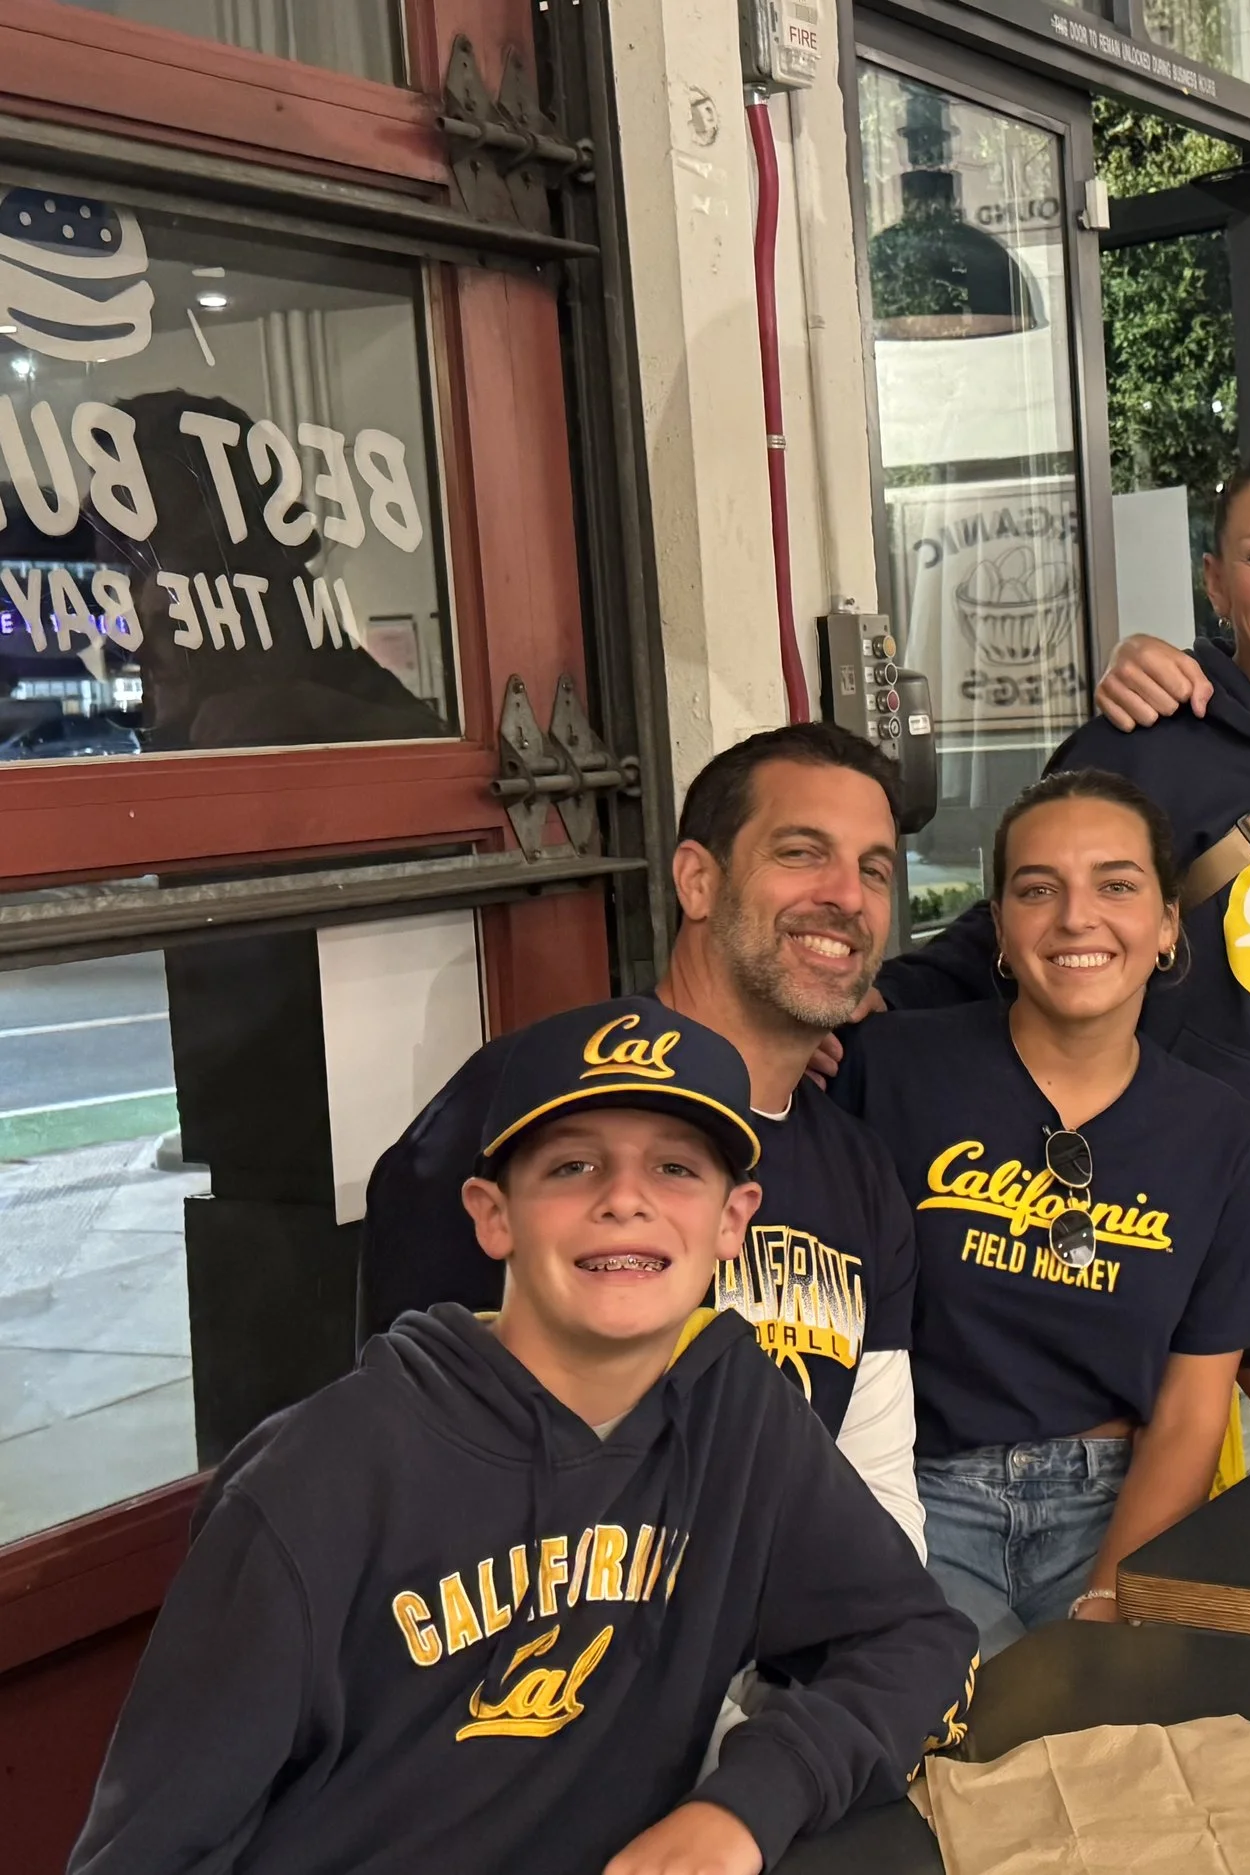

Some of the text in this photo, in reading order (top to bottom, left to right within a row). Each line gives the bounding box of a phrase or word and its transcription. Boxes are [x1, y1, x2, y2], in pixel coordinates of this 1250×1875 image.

[789, 26, 817, 50] FIRE
[1088, 28, 1098, 49] TO
[1121, 42, 1151, 72] UNLOCKED
[579, 1013, 681, 1081] Cal
[961, 1228, 1027, 1274] FIELD
[456, 1624, 614, 1743] Cal
